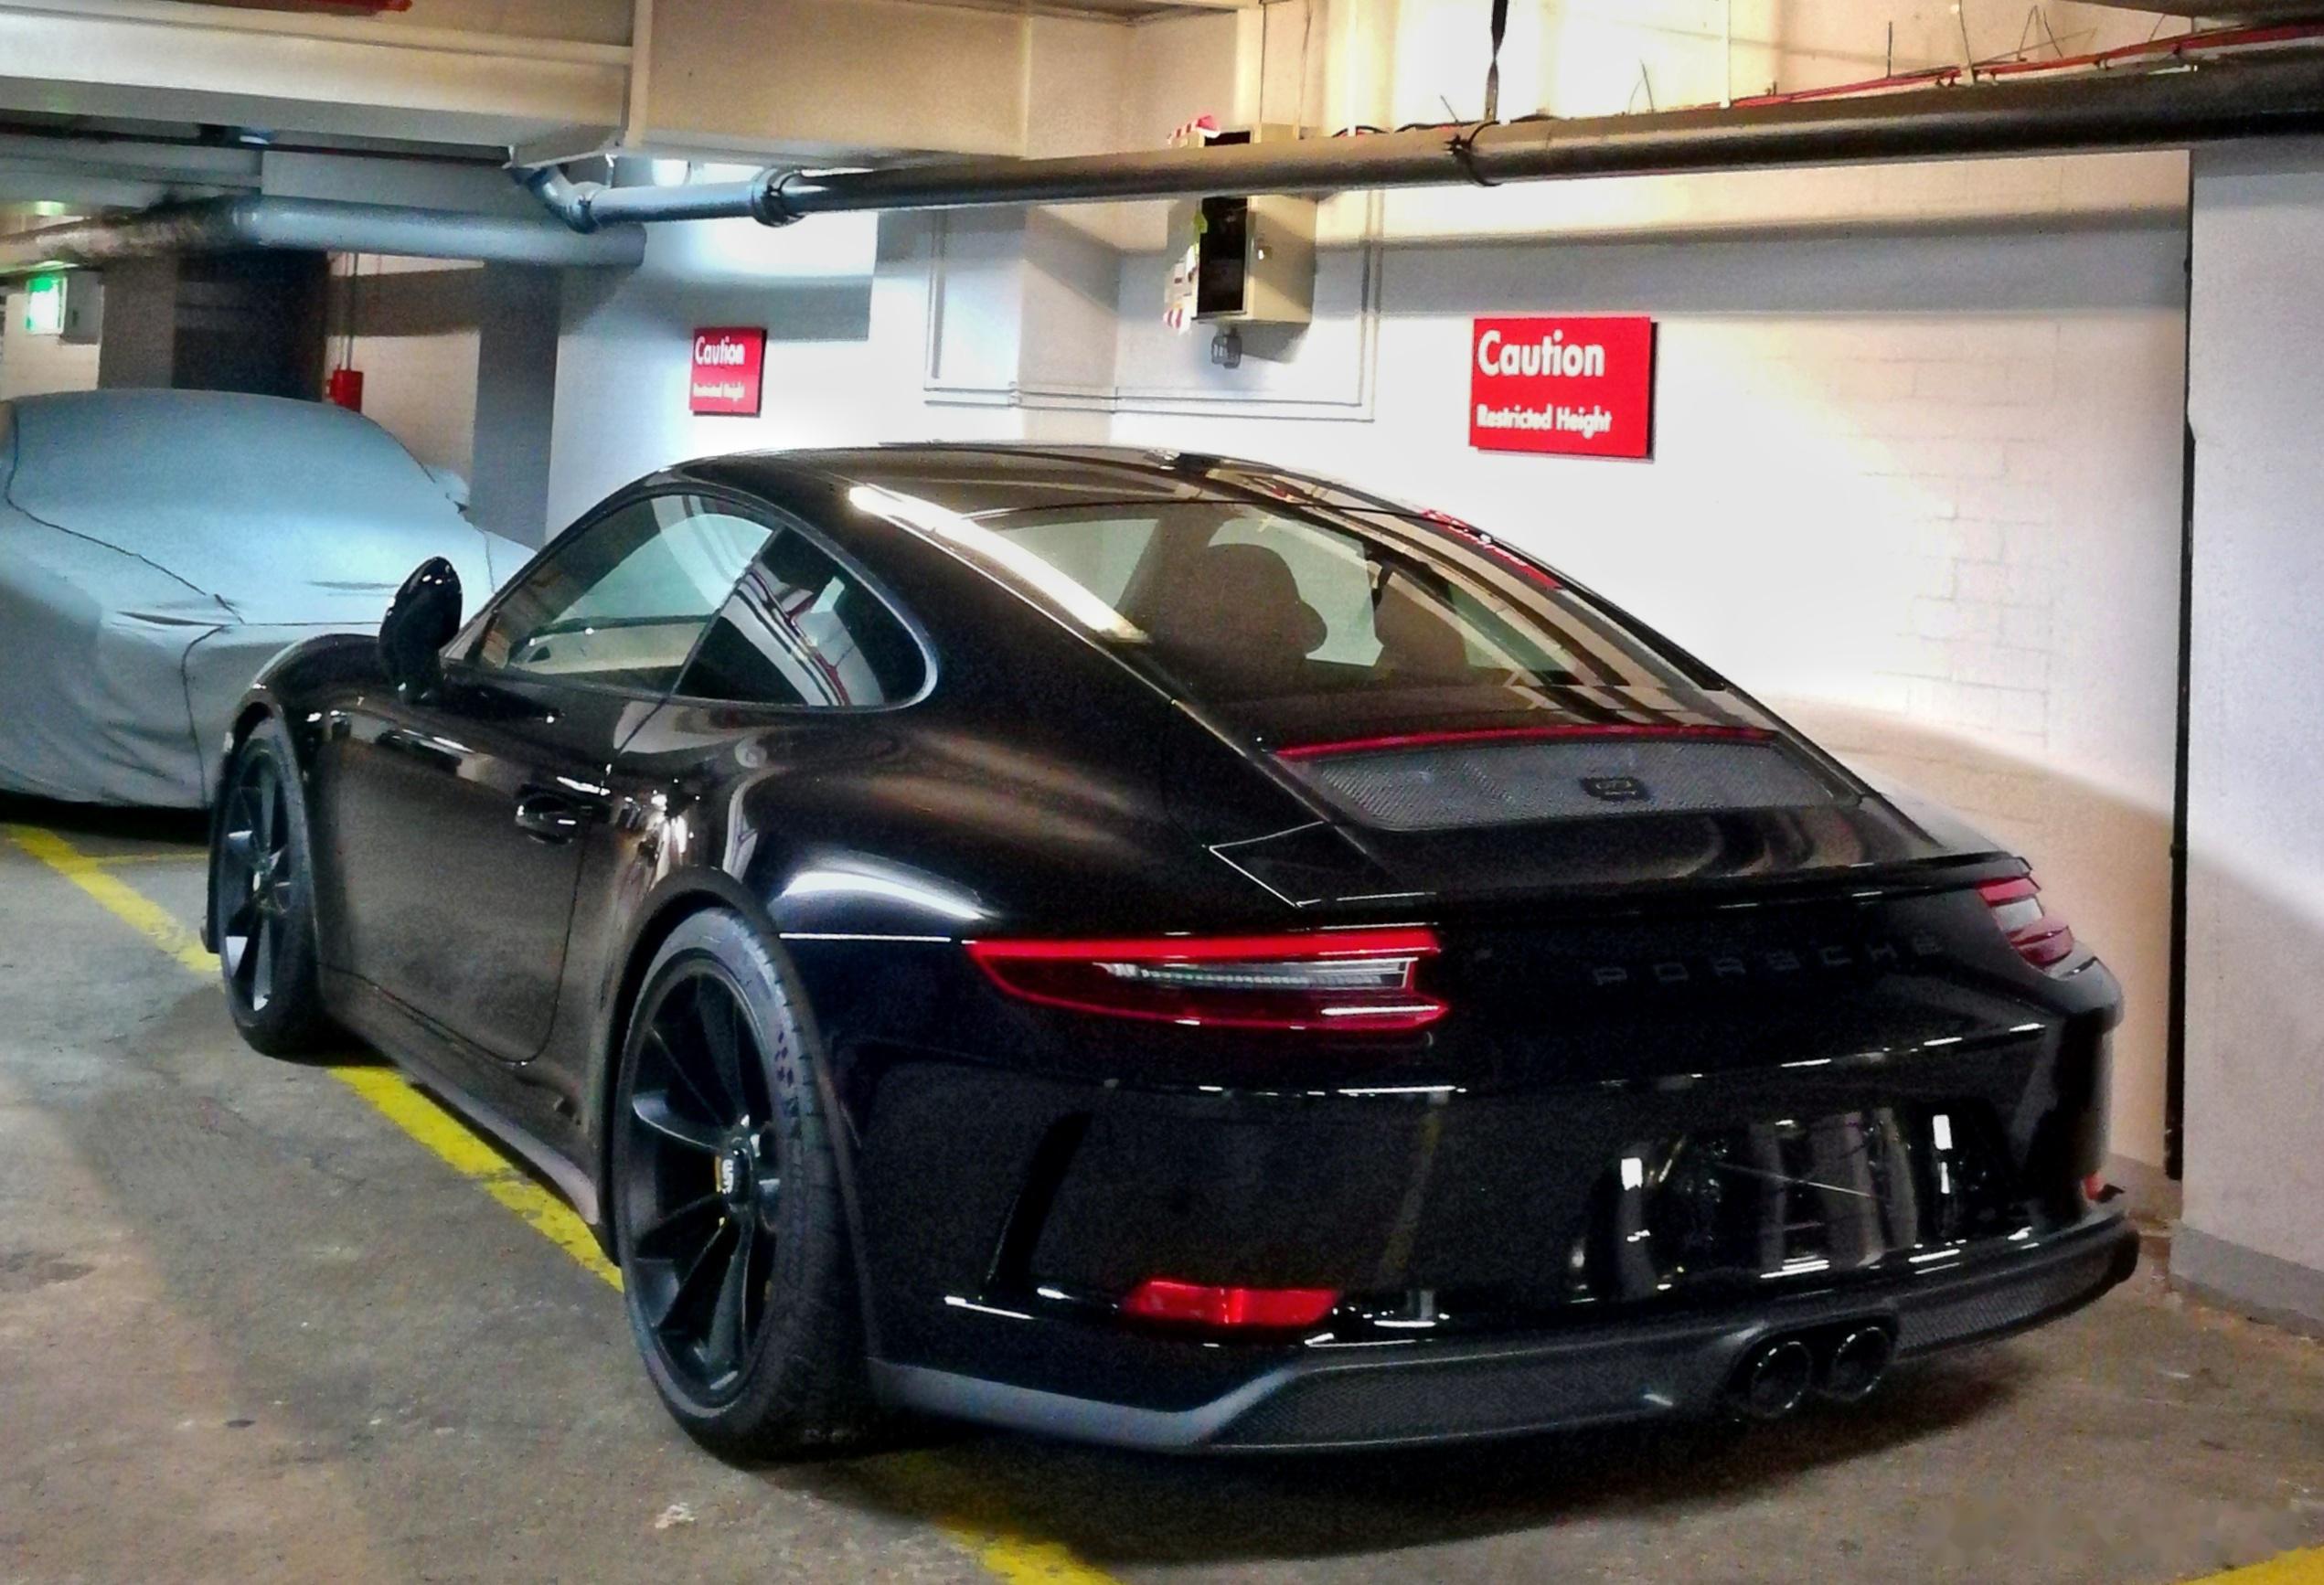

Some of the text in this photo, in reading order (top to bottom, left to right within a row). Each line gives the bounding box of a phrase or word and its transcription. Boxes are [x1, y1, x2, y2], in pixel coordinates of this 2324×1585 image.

[695, 335, 746, 367] Caution
[1477, 328, 1606, 378] Caution
[1476, 402, 1613, 440] Restricted Height
[1592, 934, 1943, 986] PORSCHE
